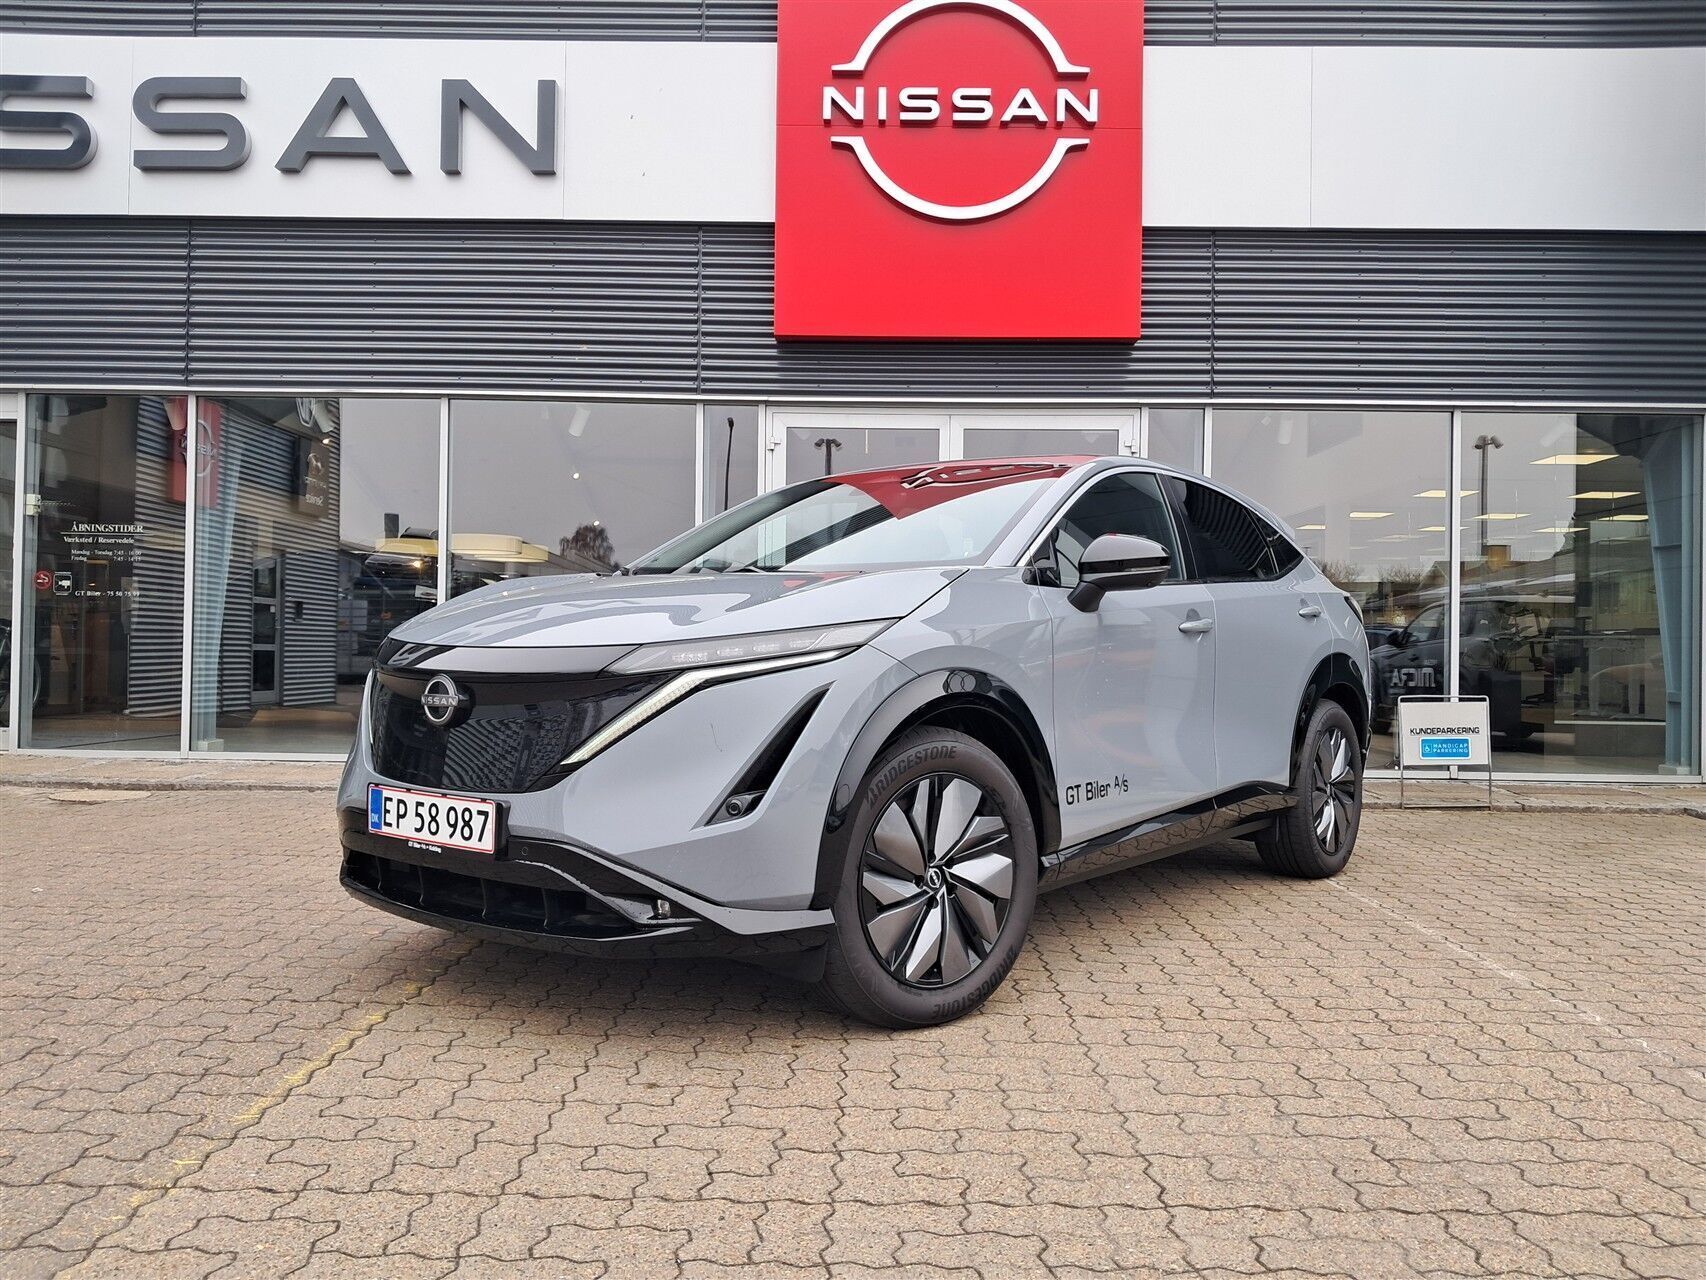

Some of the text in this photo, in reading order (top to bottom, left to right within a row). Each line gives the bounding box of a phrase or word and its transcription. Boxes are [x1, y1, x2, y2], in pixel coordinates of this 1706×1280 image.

[822, 86, 1099, 127] NISSAN
[71, 521, 144, 533] ÅBNINGSTIDER
[63, 536, 93, 544] Værksted
[1409, 727, 1480, 735] KUNDEPARKERING
[867, 745, 958, 809] BRIDGESTONE
[1065, 783, 1082, 805] GT
[1085, 780, 1111, 801] Biler
[371, 812, 379, 823] DK
[383, 796, 490, 842] EP 58 987
